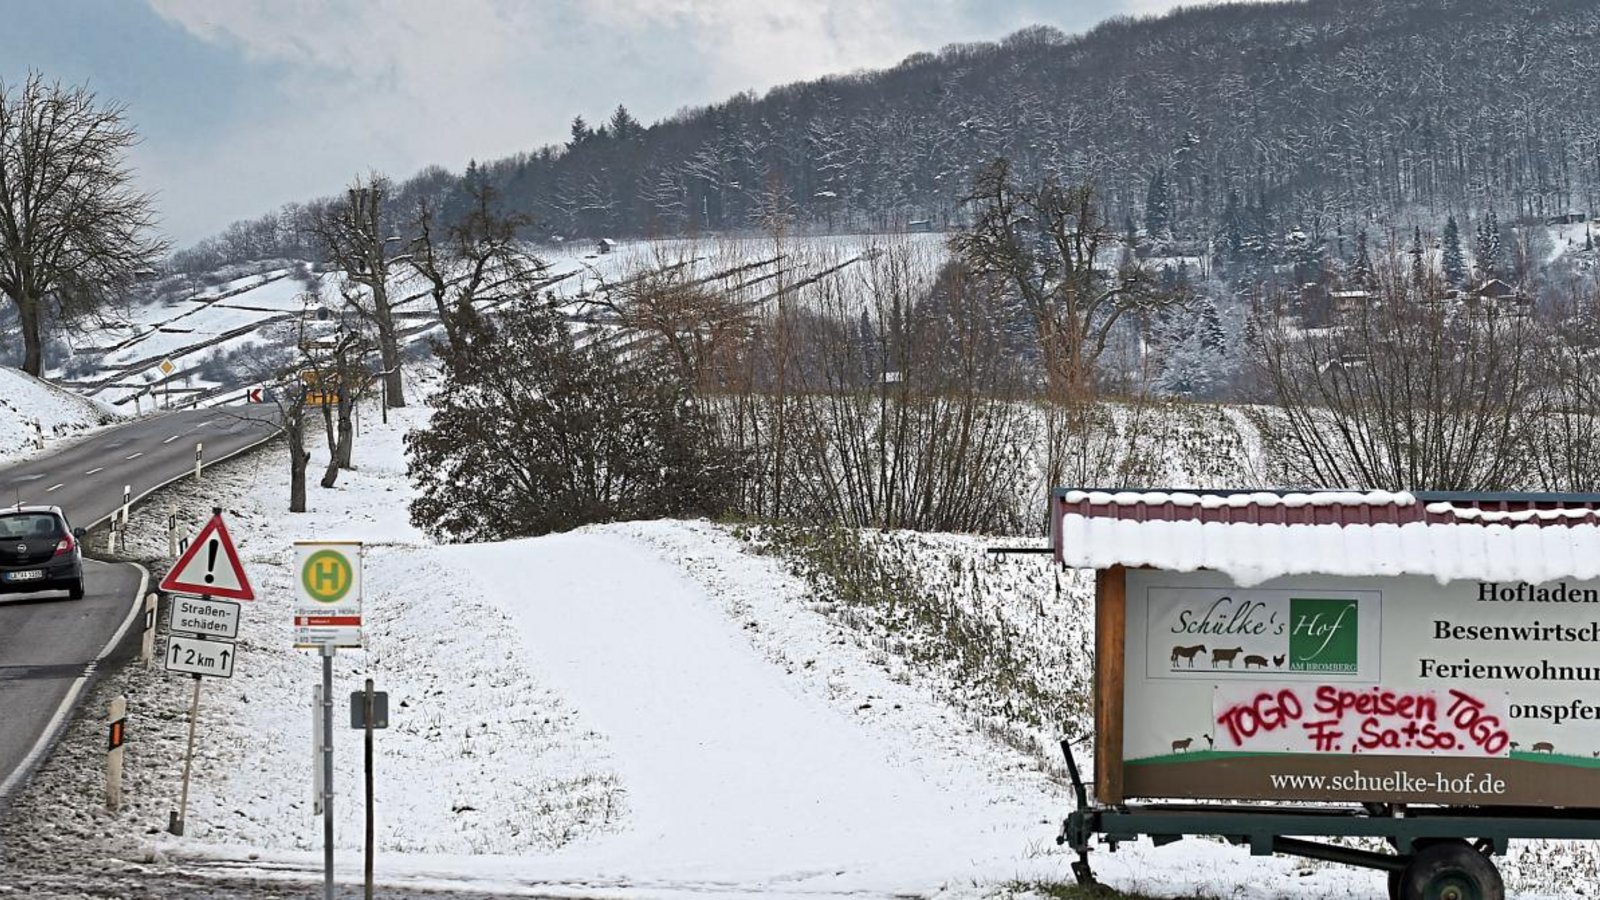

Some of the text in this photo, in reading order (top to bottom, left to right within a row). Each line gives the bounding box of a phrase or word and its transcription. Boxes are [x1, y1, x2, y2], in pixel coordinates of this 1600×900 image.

[316, 562, 339, 591] H
[1477, 582, 1600, 603] Hofladen
[181, 602, 231, 618] Straßen-
[181, 618, 228, 632] schäden
[1292, 603, 1356, 661] Hof
[184, 649, 215, 668] 2 km
[1291, 662, 1357, 672] AM BROMBERG
[1314, 685, 1437, 722] Speisen
[1270, 770, 1506, 794] www.schuelke-hof.de
